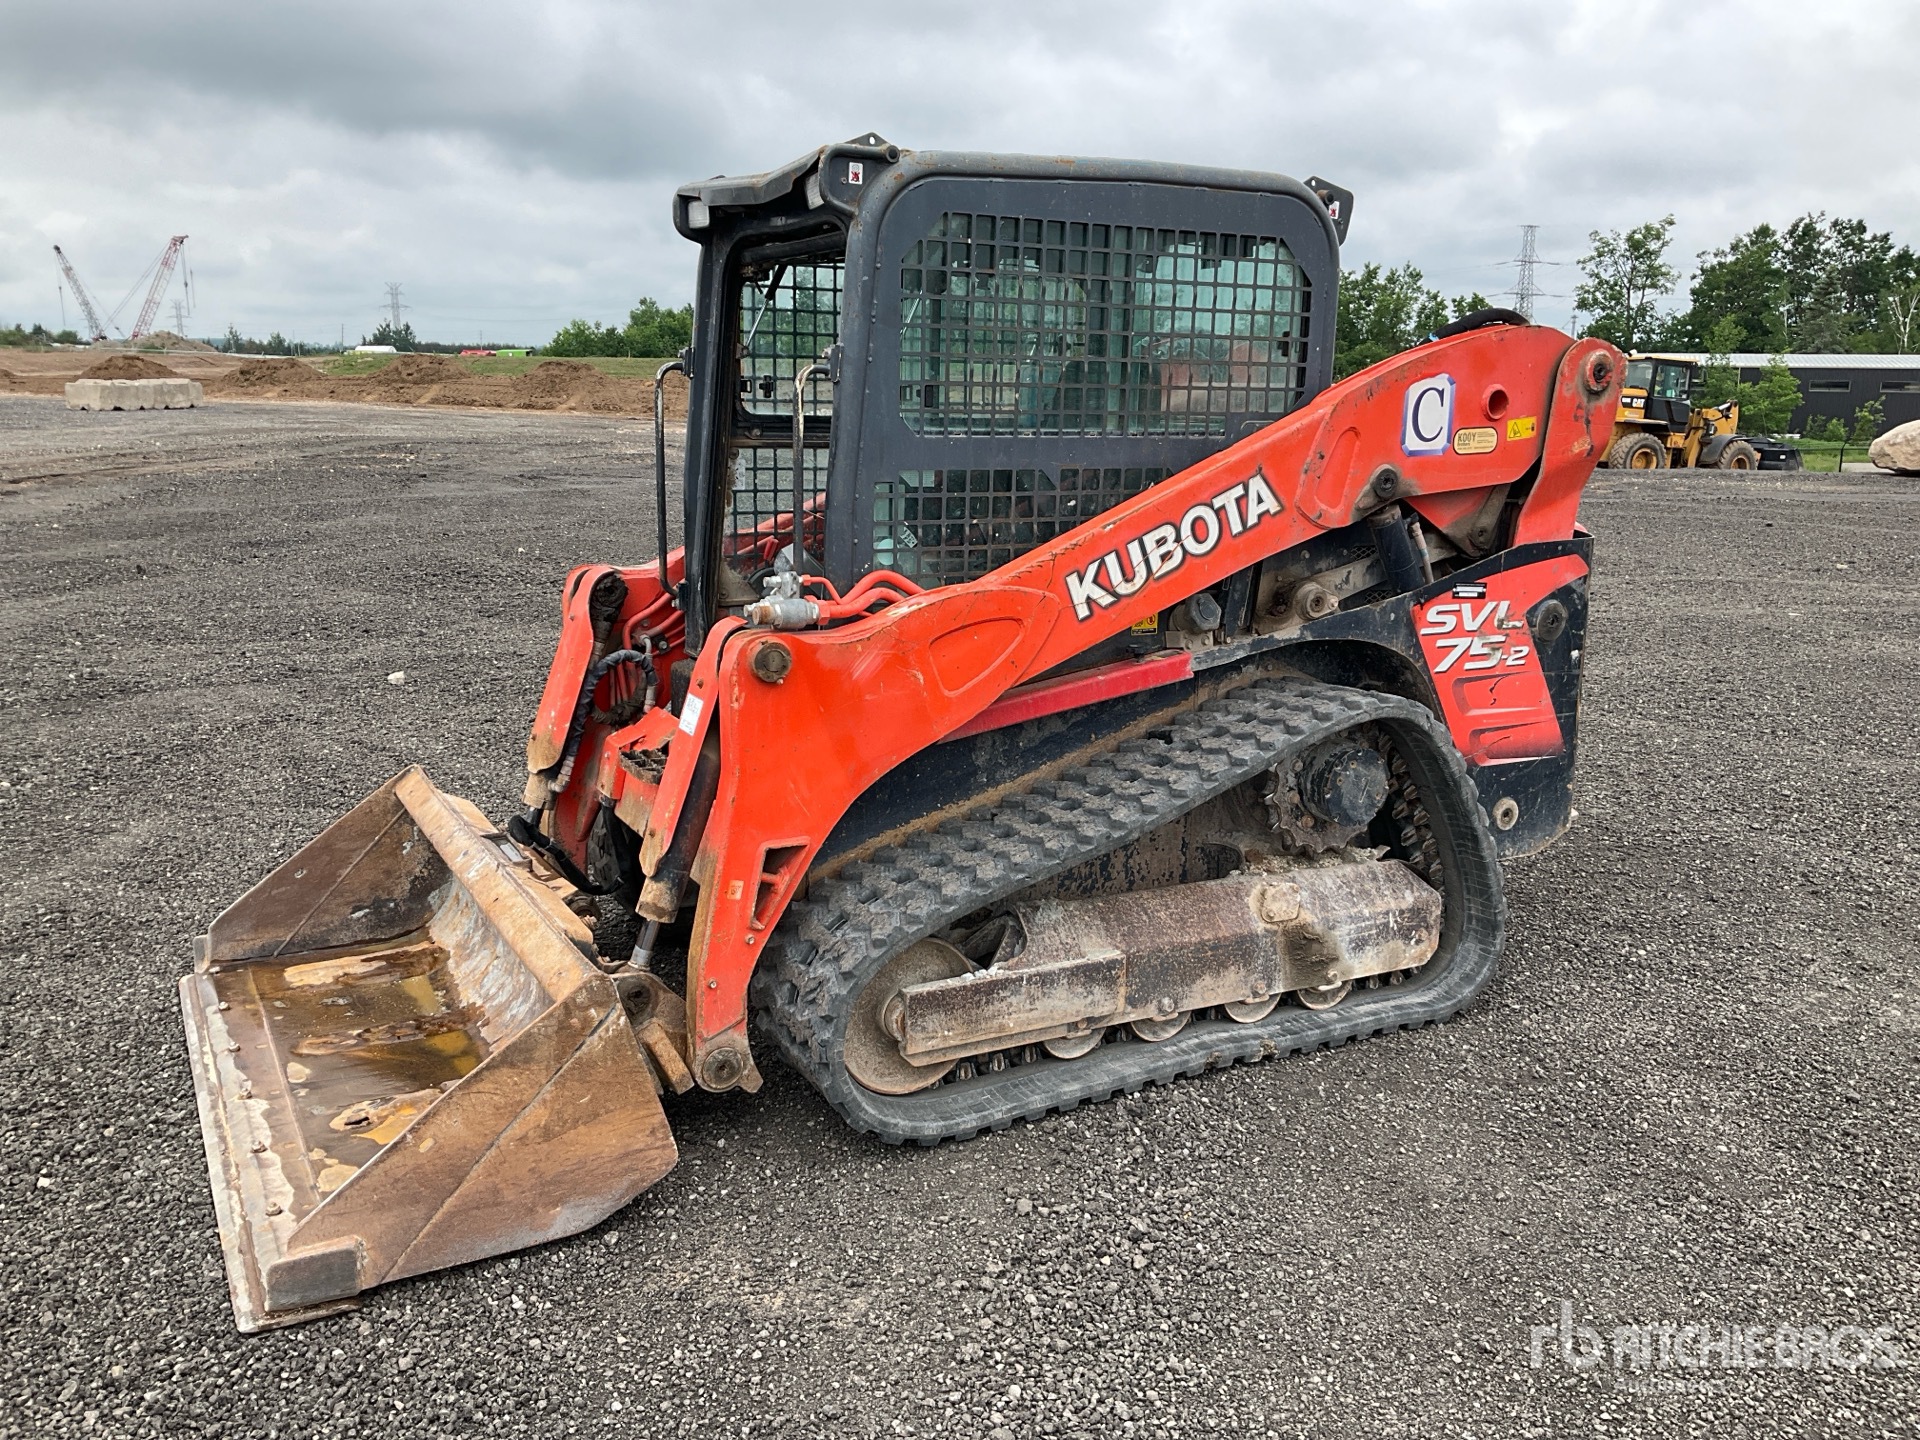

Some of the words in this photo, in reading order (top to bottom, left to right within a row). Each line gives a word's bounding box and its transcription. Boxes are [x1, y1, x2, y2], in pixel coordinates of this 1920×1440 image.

[1411, 386, 1446, 443] C
[1632, 397, 1646, 408] CAT
[1064, 473, 1284, 622] KUBOTA
[1420, 600, 1525, 636] SVL
[1433, 635, 1531, 673] 75-2
